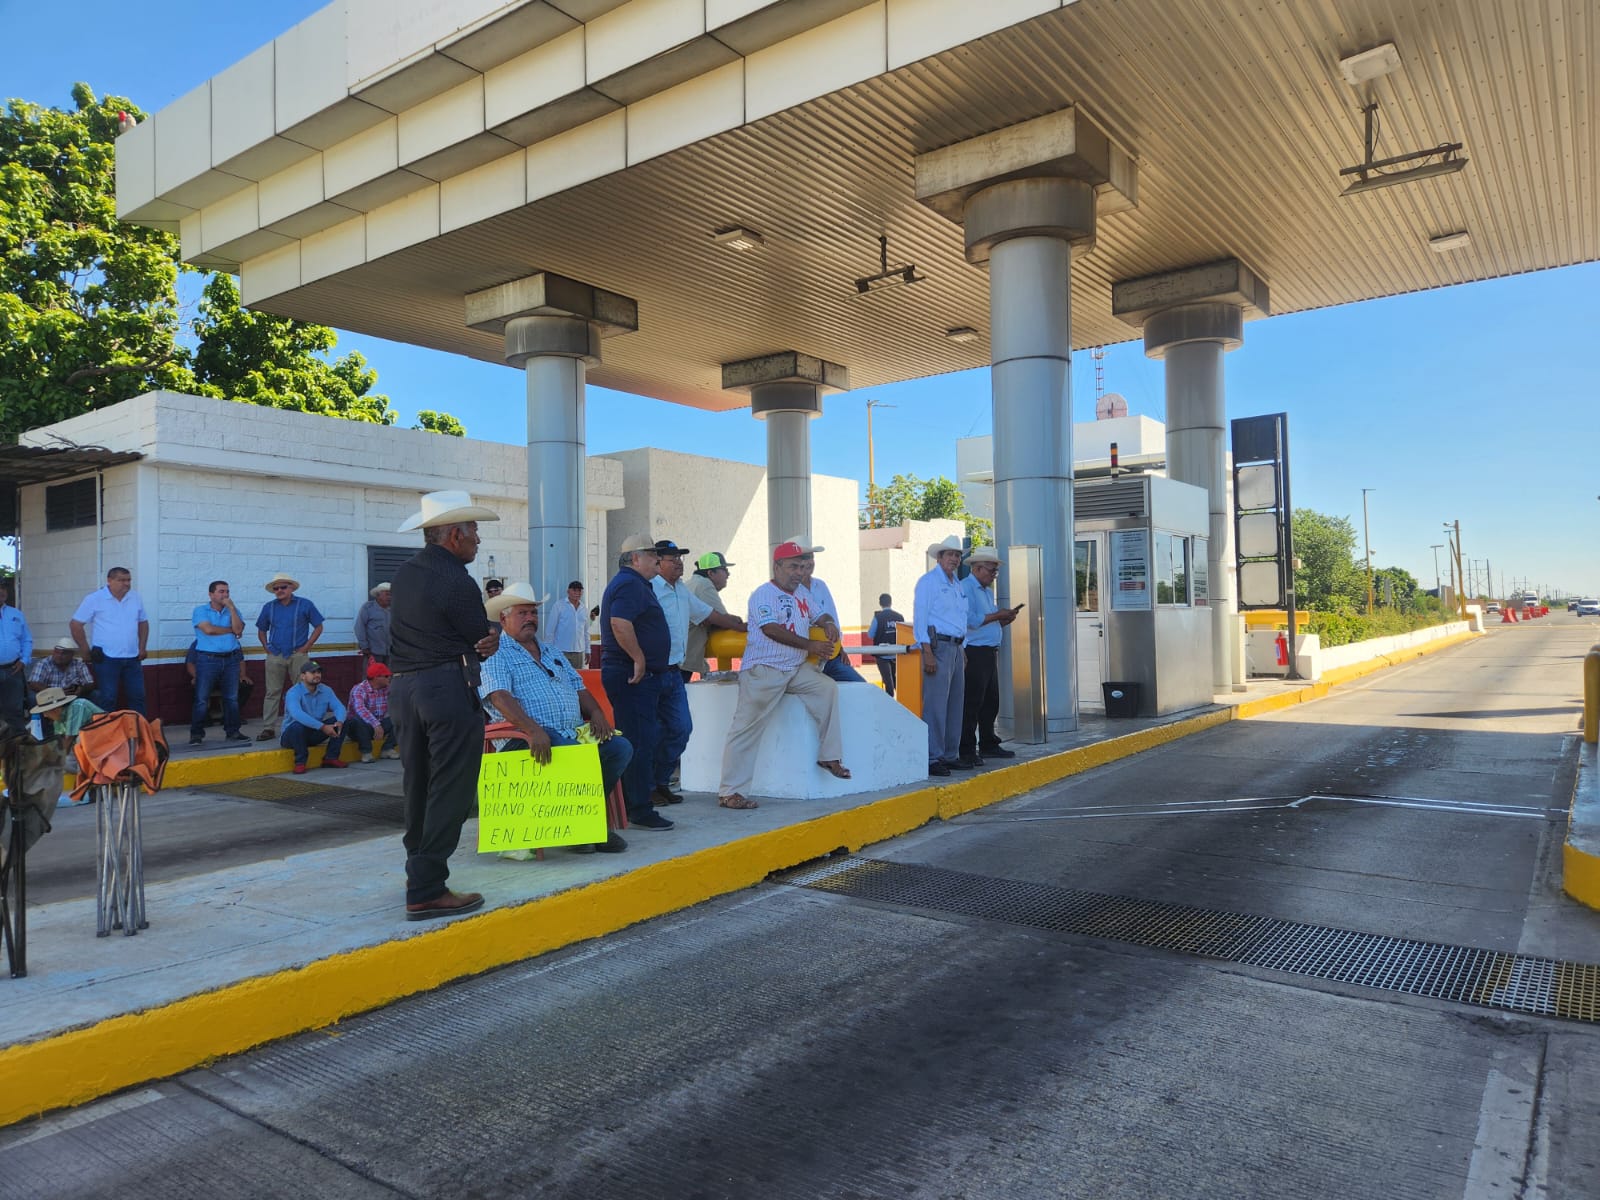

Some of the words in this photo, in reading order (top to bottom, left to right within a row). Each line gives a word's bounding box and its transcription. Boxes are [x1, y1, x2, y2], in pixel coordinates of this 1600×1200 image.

[483, 780, 552, 800] MEMORIA
[557, 782, 603, 798] BERNARDO
[483, 803, 525, 817] BRAVO
[530, 804, 599, 818] SEGUIREMOS
[490, 828, 515, 845] EN
[522, 825, 572, 842] LUCHA
